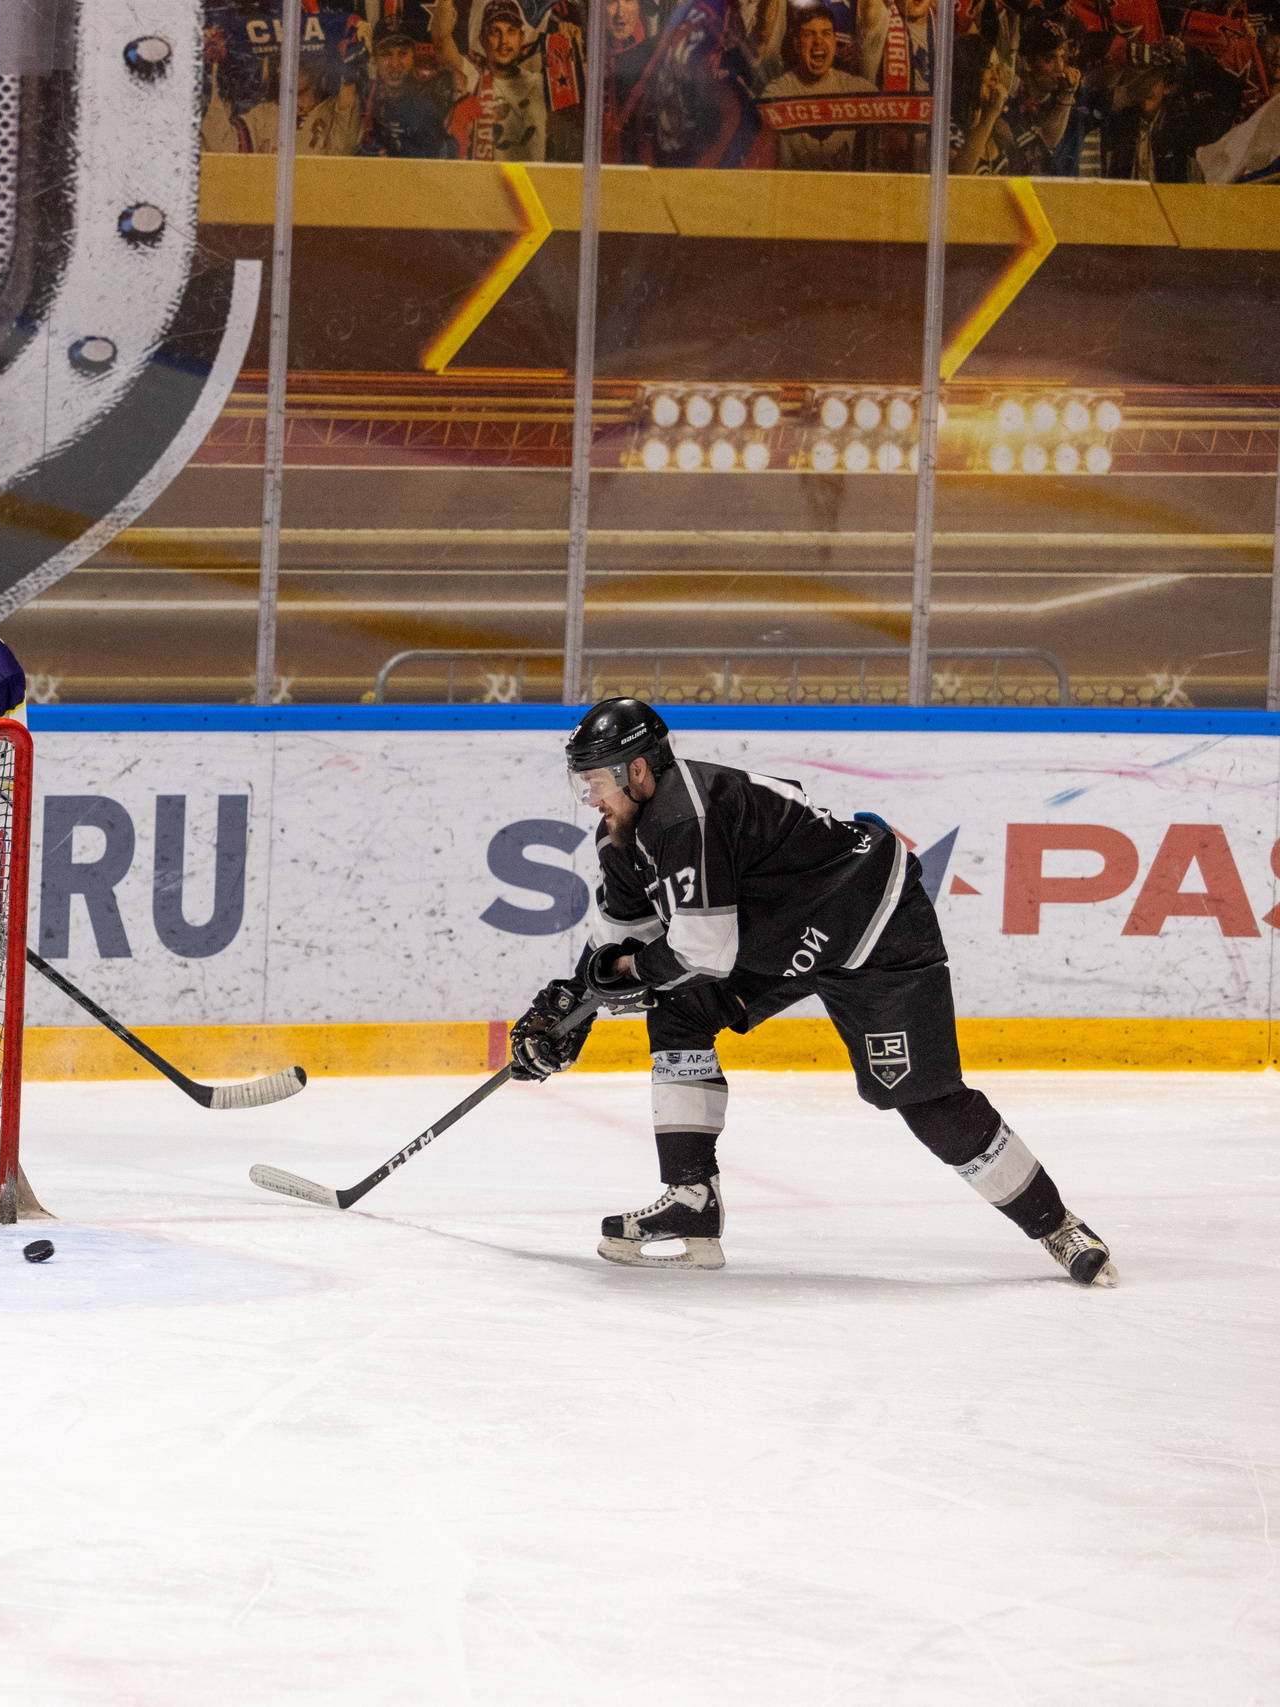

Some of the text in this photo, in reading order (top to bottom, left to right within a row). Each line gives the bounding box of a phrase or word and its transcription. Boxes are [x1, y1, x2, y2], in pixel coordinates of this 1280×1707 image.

[621, 727, 648, 745] BAUER
[1001, 823, 1280, 938] PA
[868, 1038, 904, 1057] LR
[678, 1066, 713, 1077] СТРОЙ
[385, 1128, 436, 1174] CCM
